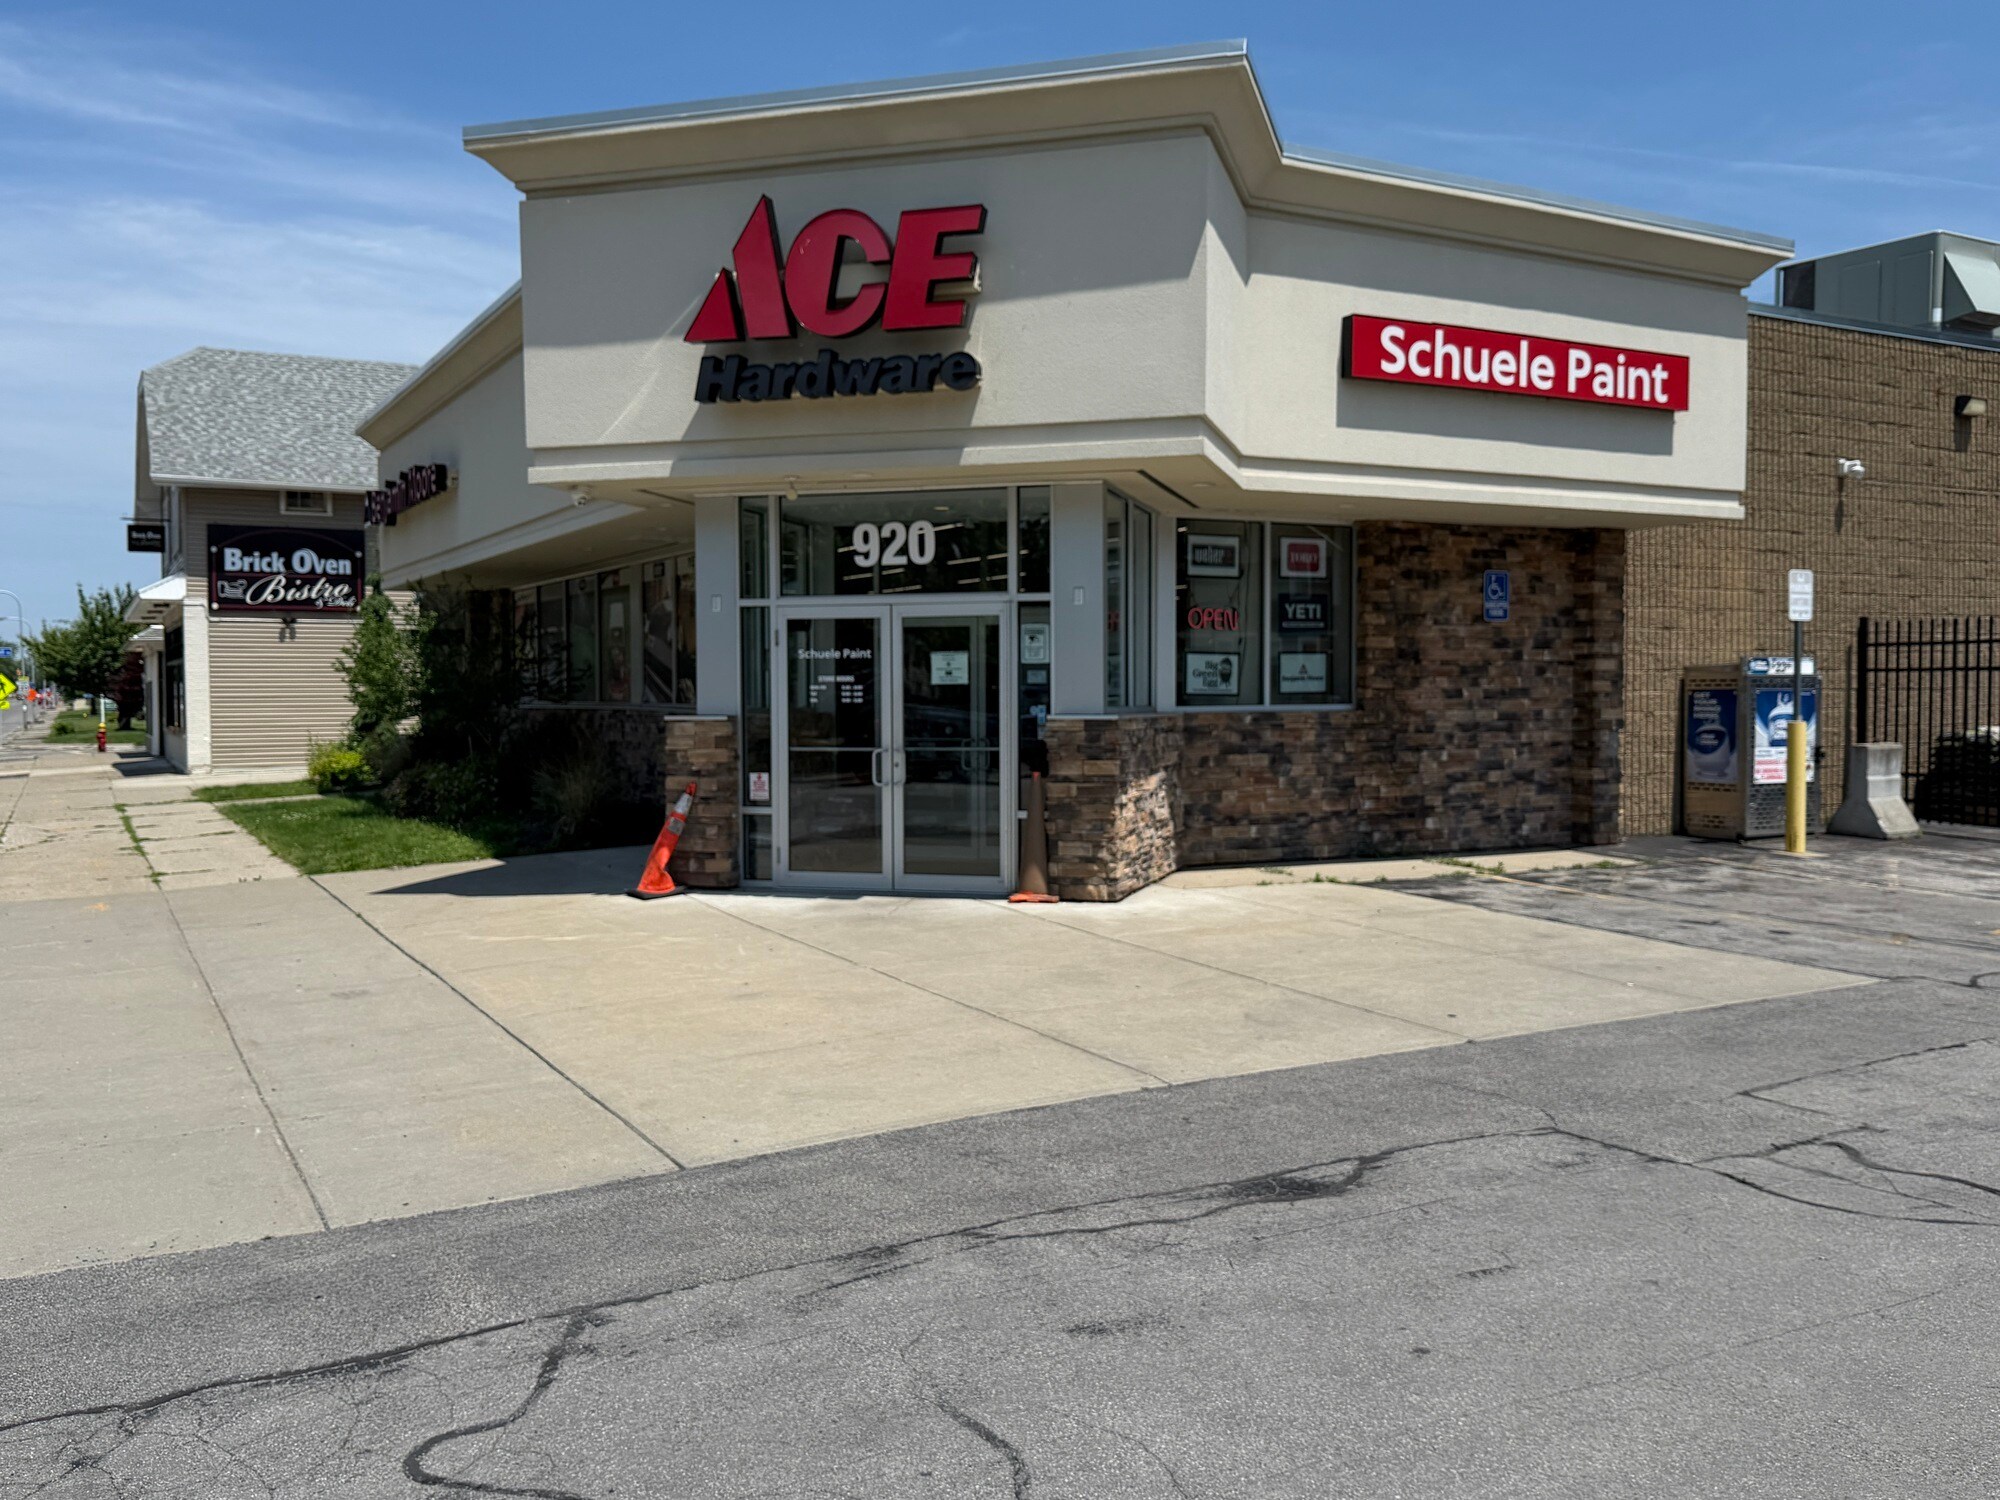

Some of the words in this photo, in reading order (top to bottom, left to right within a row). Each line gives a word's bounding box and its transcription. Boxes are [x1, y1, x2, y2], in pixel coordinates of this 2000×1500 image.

[684, 194, 987, 343] ACE
[695, 350, 981, 403] Hardware
[1379, 325, 1556, 391] Schuele
[1567, 348, 1669, 404] Paint
[852, 520, 936, 568] 920
[224, 547, 286, 573] Brick
[292, 548, 352, 575] Oven
[246, 574, 352, 605] Bistro
[1187, 607, 1240, 631] OPEN
[1285, 603, 1322, 620] YETI
[798, 648, 841, 659] Schuele
[842, 648, 872, 659] Paint
